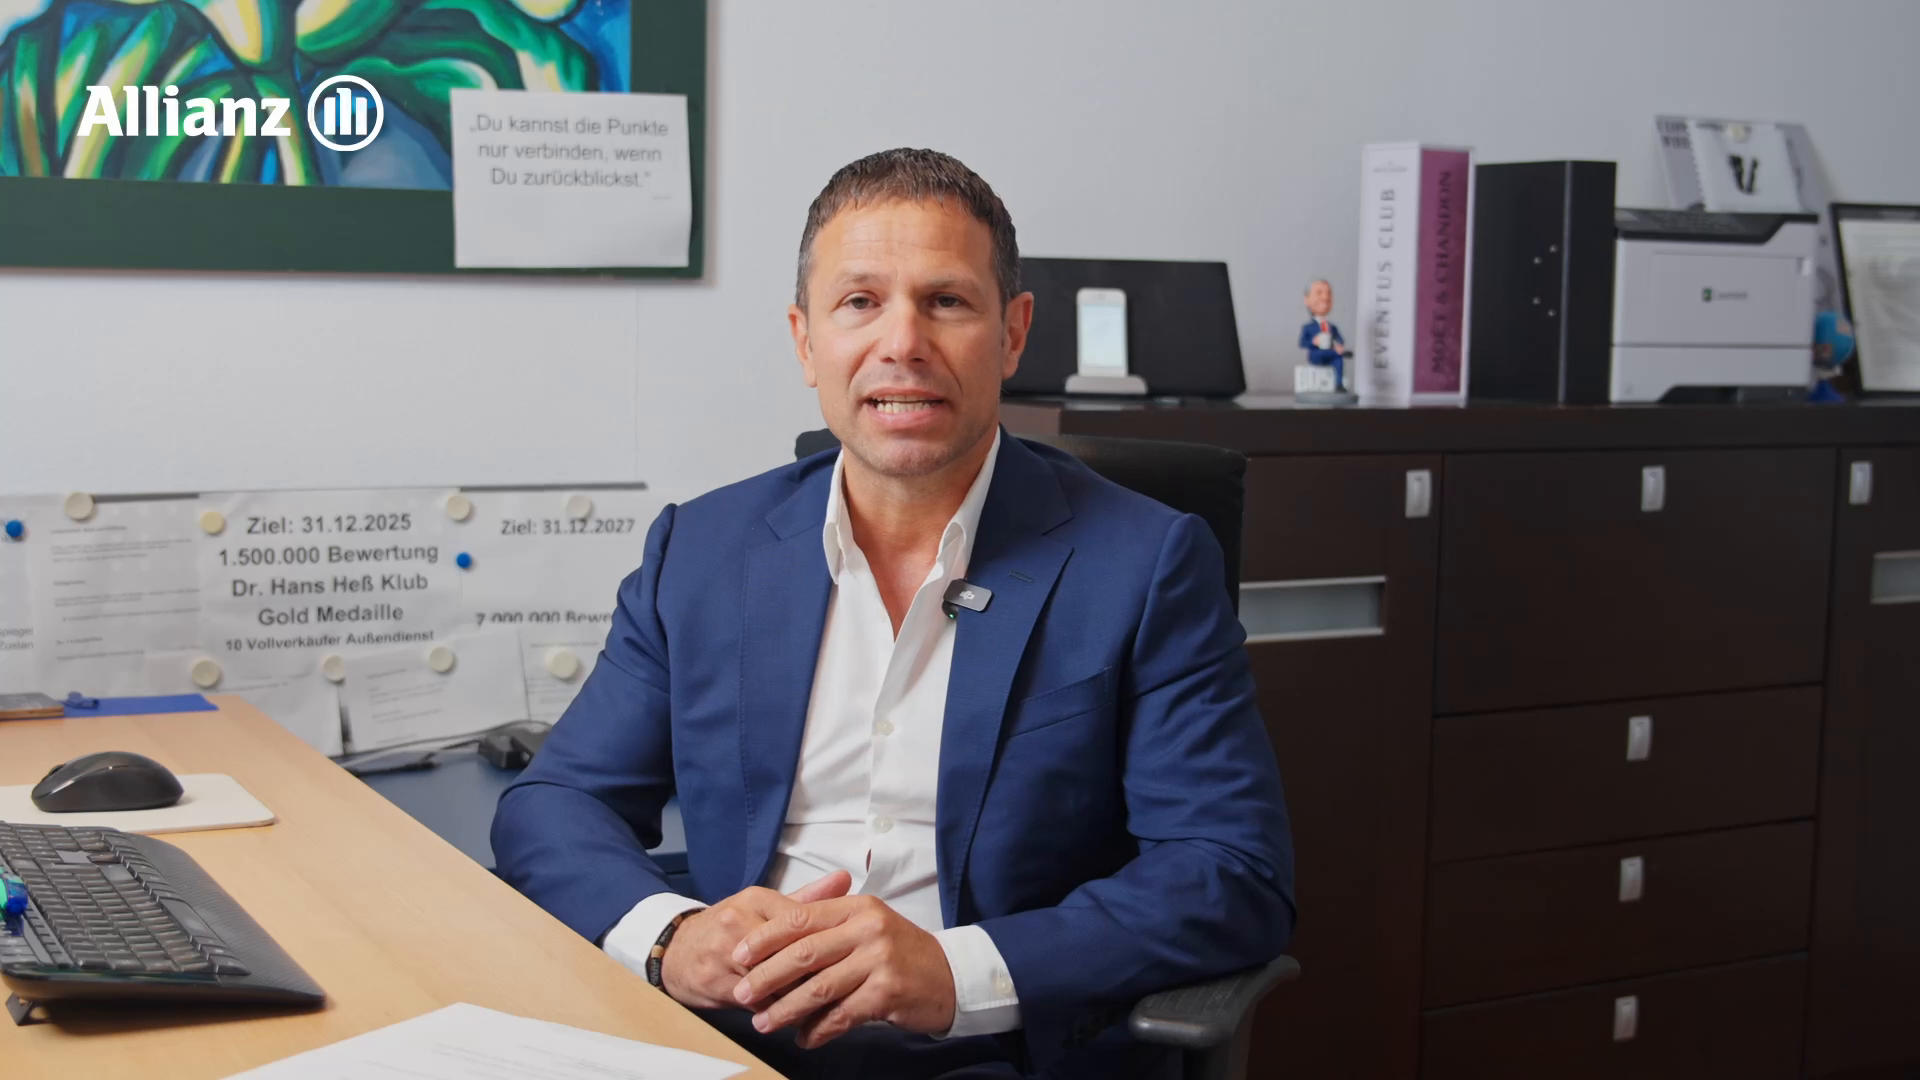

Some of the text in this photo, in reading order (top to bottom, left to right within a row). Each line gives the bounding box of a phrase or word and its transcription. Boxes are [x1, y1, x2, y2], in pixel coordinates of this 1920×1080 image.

[509, 115, 569, 134] kannst
[575, 117, 601, 135] die
[607, 118, 669, 137] Punkte
[478, 142, 663, 163] nur verbinden, wenn
[491, 168, 517, 185] Du
[1377, 188, 1396, 250] CLUB
[1434, 171, 1452, 285] CHANDON
[1372, 260, 1393, 371] EVENTUS
[247, 513, 412, 535] Ziel: 31.12.2025
[501, 518, 636, 536] Ziel: 31.12.2027
[219, 545, 439, 566] 1.500.000 Bewertung
[232, 573, 429, 597] Dr. Hans Heß Klub
[258, 603, 403, 627] Gold Medaille
[226, 629, 434, 651] 10 Vollverkäufer Außendienst
